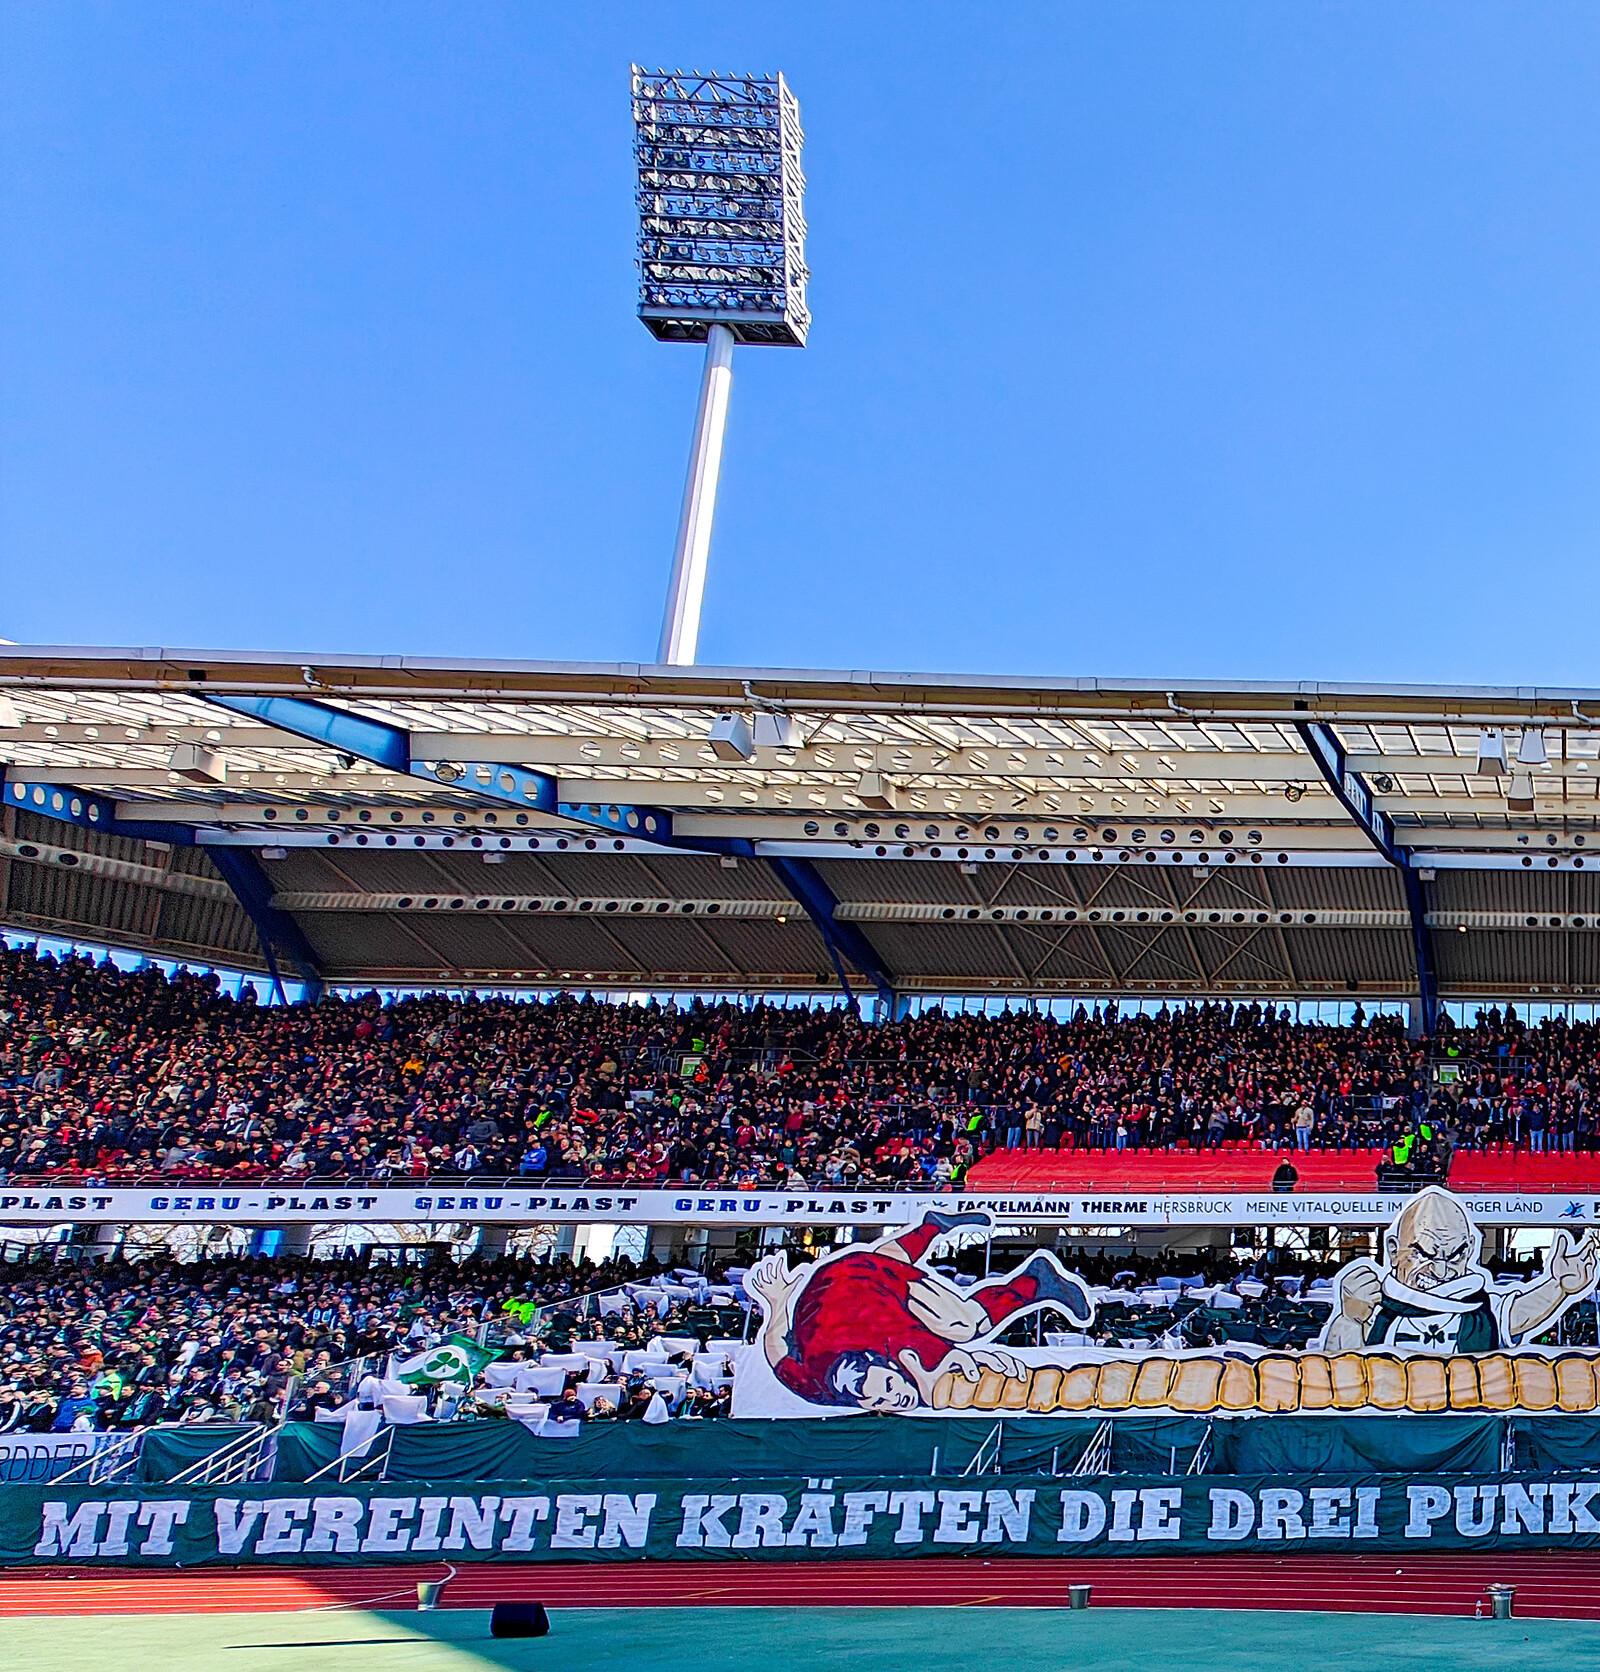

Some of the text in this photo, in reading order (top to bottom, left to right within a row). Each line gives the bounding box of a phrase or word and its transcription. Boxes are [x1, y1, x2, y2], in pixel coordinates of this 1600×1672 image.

[1081, 1201, 1148, 1213] THERME
[1152, 1202, 1232, 1213] HERSBRUCK
[1245, 1202, 1288, 1213] MEINE
[1292, 1202, 1383, 1214] VITALQUELLE
[1387, 1202, 1402, 1213] IM
[1506, 1202, 1543, 1213] LAND
[33, 1500, 191, 1557] MIT
[213, 1493, 656, 1555] VEREINTEN
[676, 1479, 1036, 1548] KRÄFTEN
[1057, 1486, 1183, 1543] DIE
[1206, 1486, 1381, 1540] DREI
